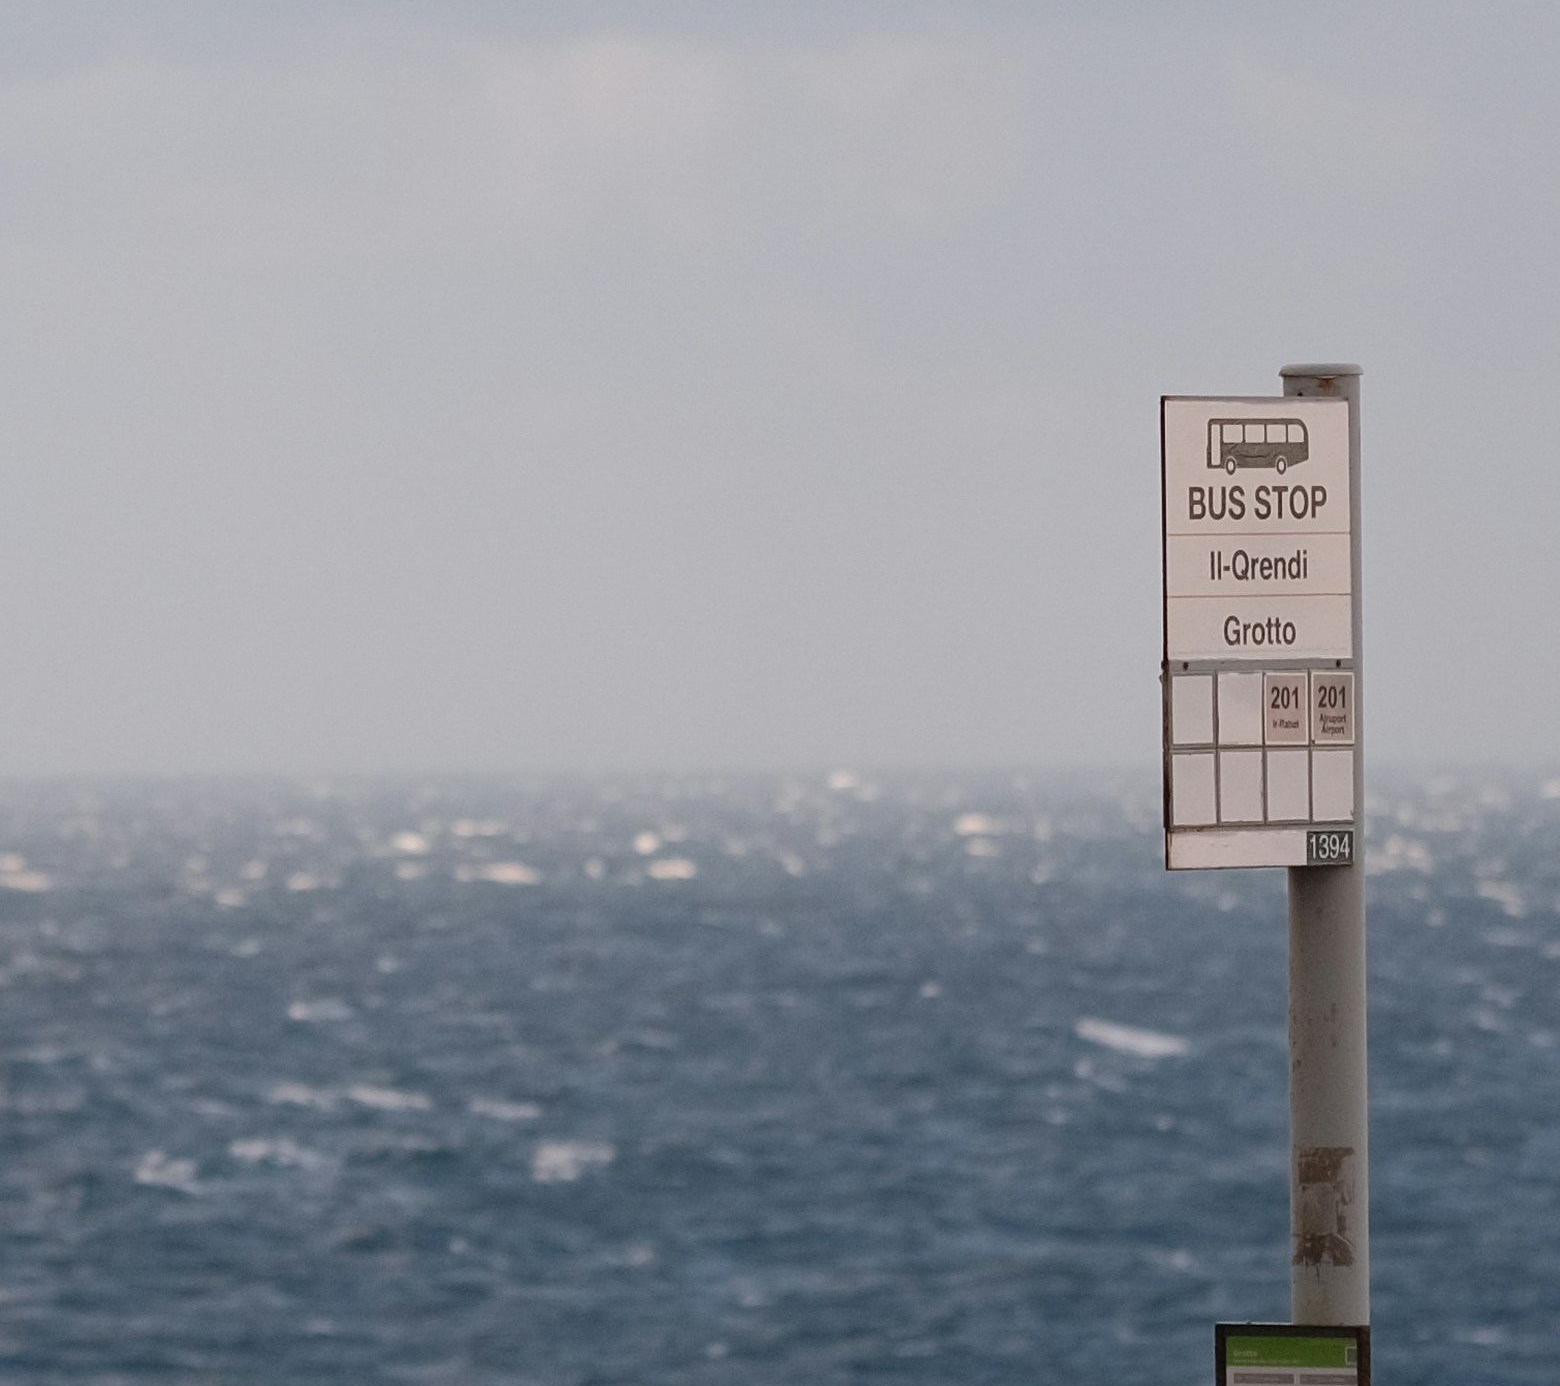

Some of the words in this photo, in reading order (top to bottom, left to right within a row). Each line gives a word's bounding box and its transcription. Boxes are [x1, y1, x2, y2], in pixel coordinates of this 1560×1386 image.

[1189, 486, 1246, 520] BUS
[1254, 485, 1327, 520] STOP
[1209, 548, 1308, 582] Il-Qrendi
[1223, 615, 1297, 647] Grotto
[1271, 686, 1299, 710] 201
[1318, 685, 1346, 709] 201
[1321, 723, 1345, 735] Airport
[1309, 833, 1350, 860] 1394
